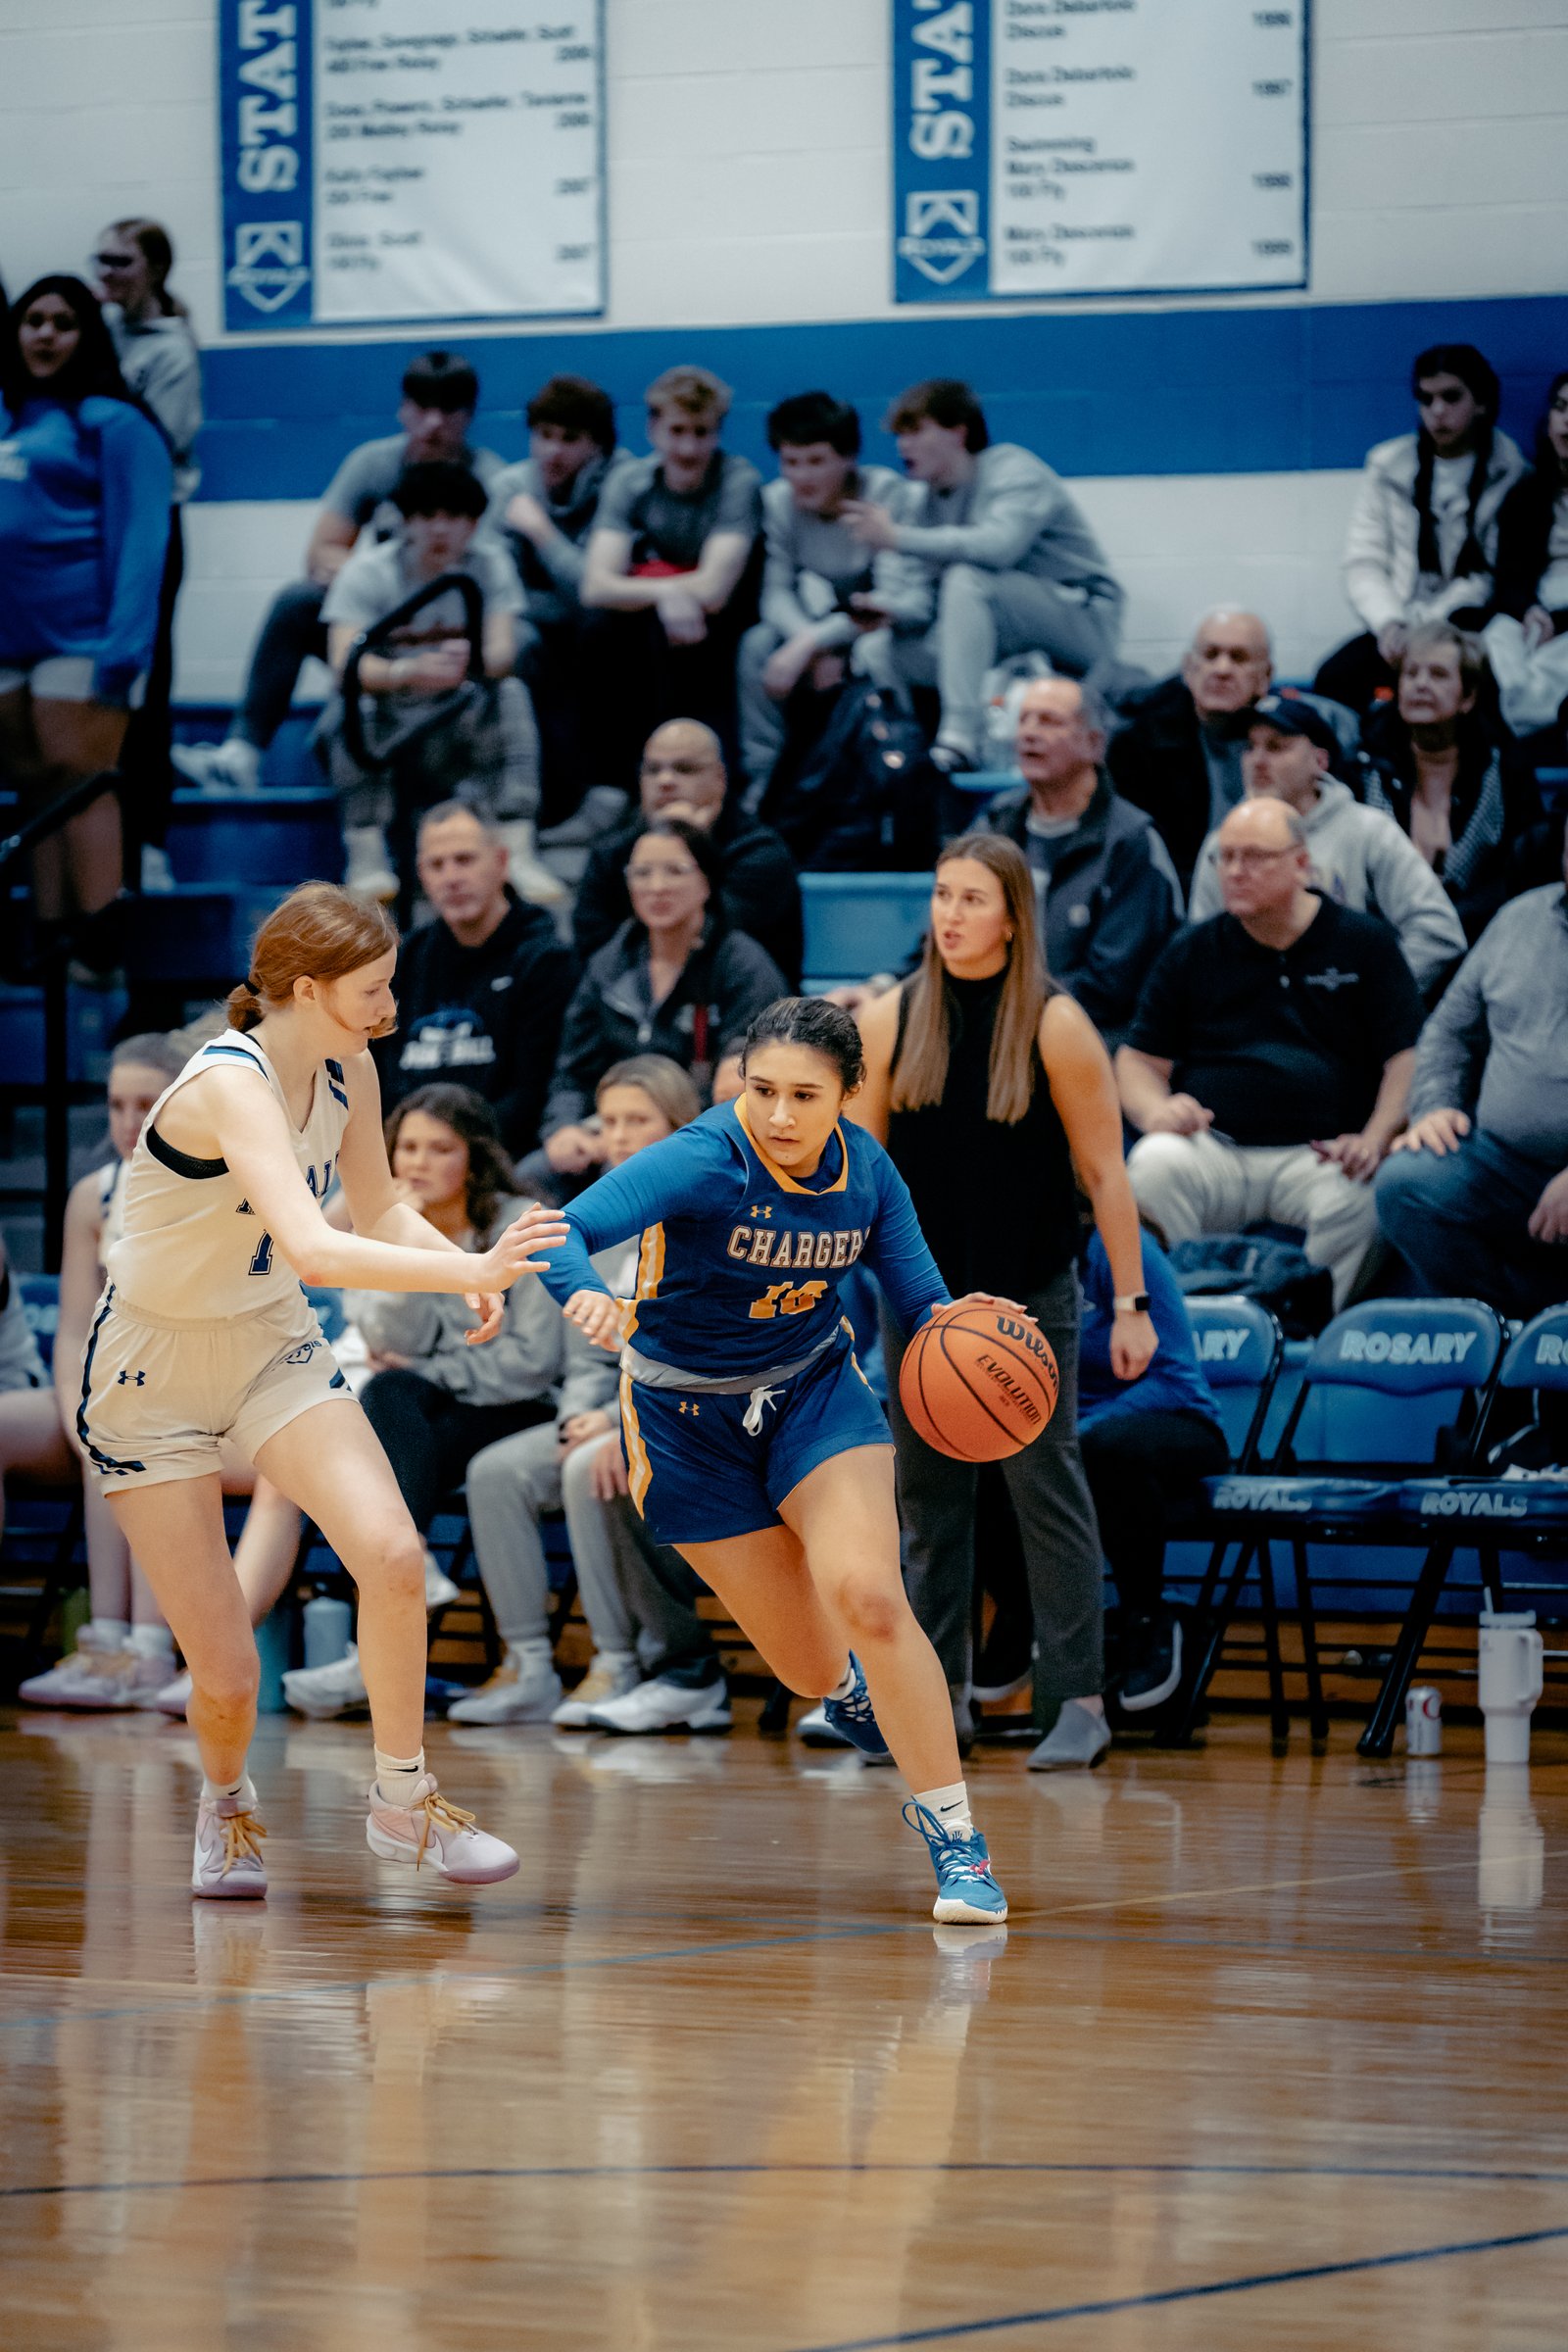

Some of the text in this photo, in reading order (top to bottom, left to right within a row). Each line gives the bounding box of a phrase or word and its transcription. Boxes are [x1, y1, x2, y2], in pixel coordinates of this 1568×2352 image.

[236, 0, 300, 193] STAT
[908, 0, 974, 160] STA
[726, 1225, 871, 1269] CHARGER
[1339, 1329, 1478, 1365] ROSARY
[975, 1353, 1042, 1426] EVOLUTION
[1420, 1491, 1528, 1517] ROYALS
